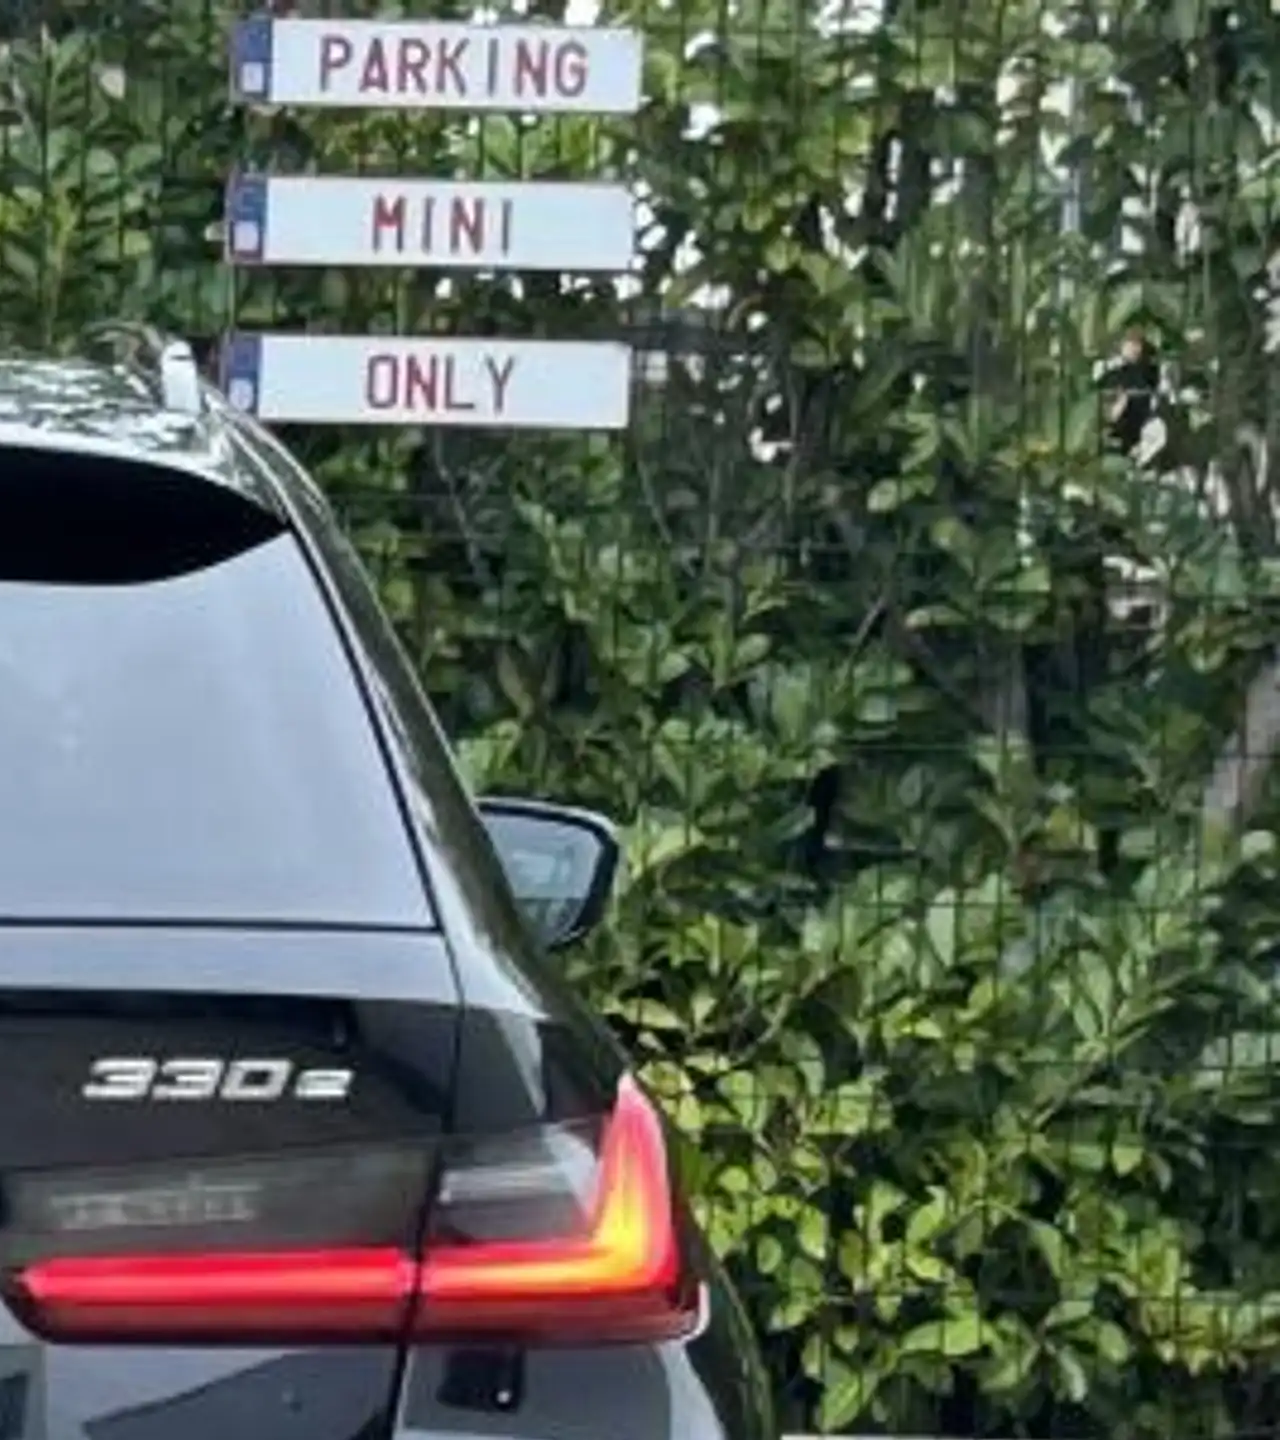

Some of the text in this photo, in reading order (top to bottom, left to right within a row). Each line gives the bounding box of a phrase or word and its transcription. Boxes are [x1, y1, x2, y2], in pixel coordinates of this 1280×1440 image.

[318, 35, 589, 98] PARKING
[371, 195, 514, 256] MINI
[365, 353, 515, 415] ONLY
[81, 1058, 354, 1100] 330e
